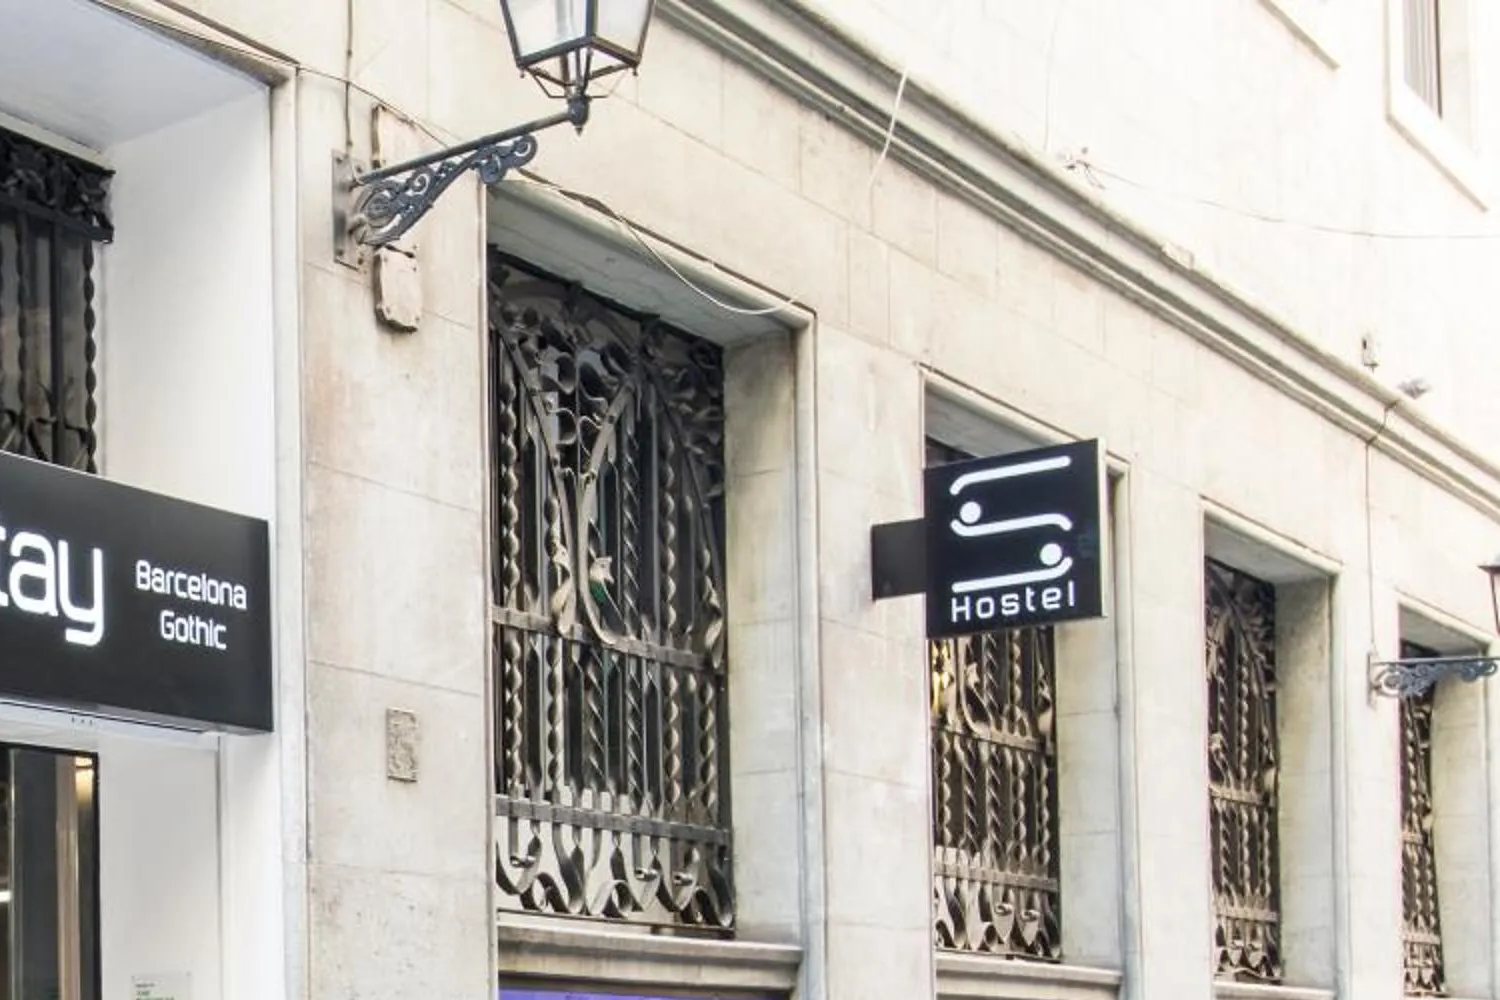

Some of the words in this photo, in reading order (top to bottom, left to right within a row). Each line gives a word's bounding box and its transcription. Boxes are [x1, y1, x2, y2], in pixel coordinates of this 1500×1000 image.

[135, 559, 248, 610] Barcelona
[951, 580, 1074, 622] Hostel
[160, 609, 227, 650] Gothic
